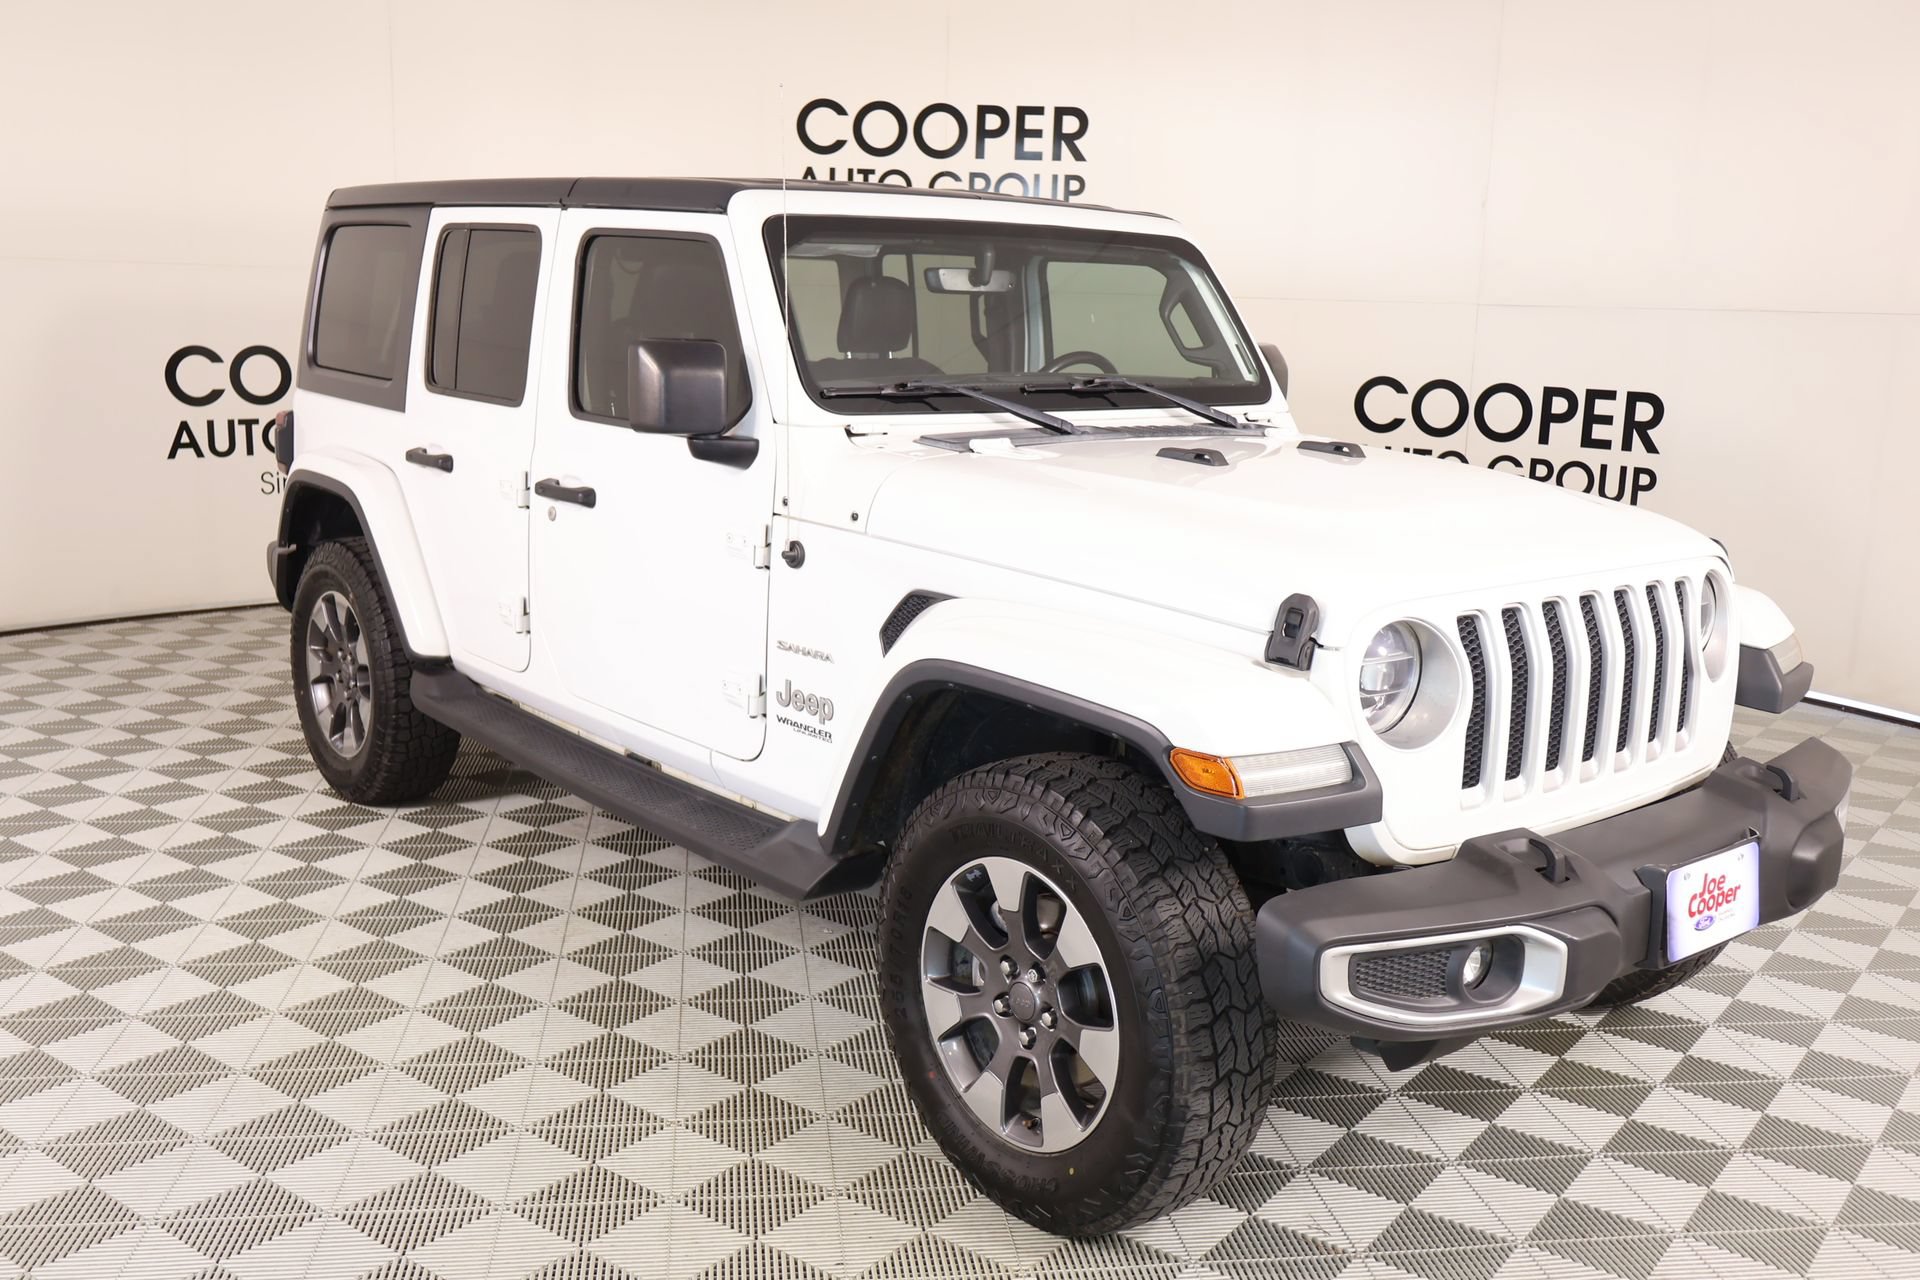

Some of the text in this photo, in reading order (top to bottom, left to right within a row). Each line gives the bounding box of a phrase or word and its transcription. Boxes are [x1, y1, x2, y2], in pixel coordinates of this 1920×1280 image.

[796, 98, 1090, 162] COOPER
[1353, 375, 1665, 455] COOPER
[776, 640, 834, 664] SAHARA
[775, 678, 835, 726] Jeep
[775, 714, 833, 739] WRANGLER
[1687, 884, 1742, 919] Cooper
[1698, 872, 1727, 899] Joe
